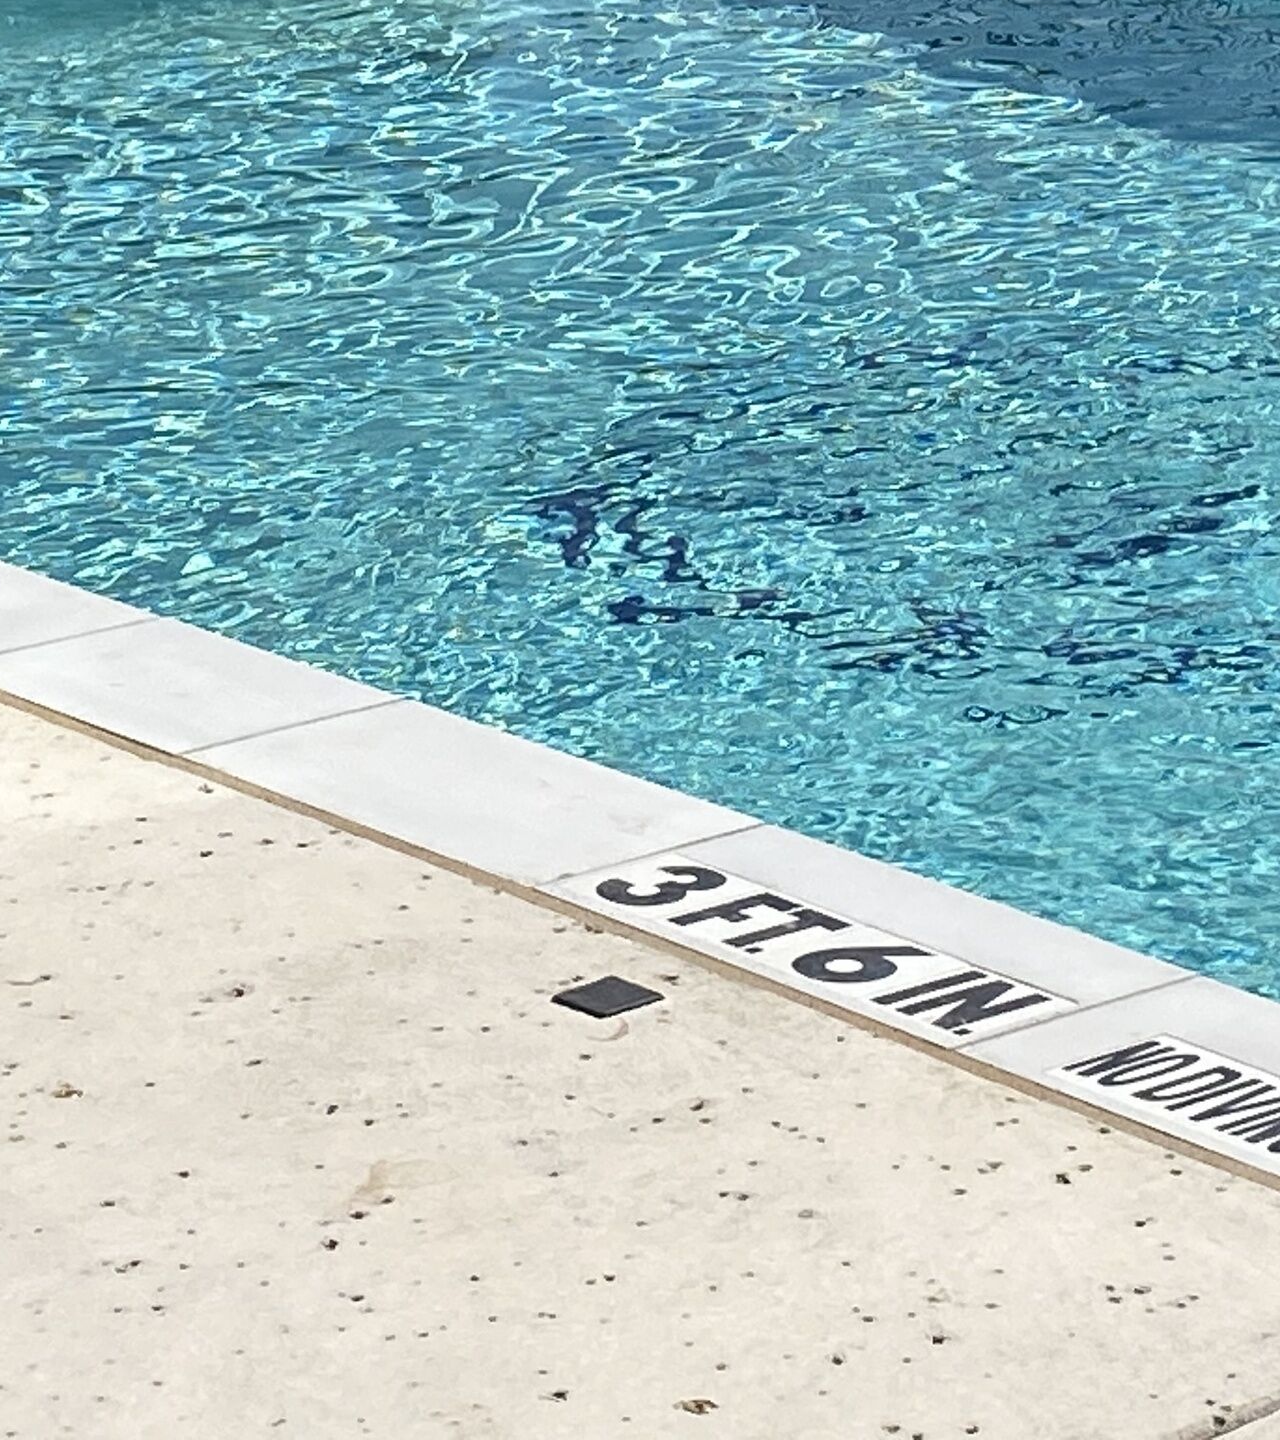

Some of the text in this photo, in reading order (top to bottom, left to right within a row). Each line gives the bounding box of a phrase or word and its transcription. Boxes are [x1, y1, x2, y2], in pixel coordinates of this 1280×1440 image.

[595, 865, 1052, 1036] 3 FT. 6 IN.
[1063, 1040, 1200, 1087] NO
